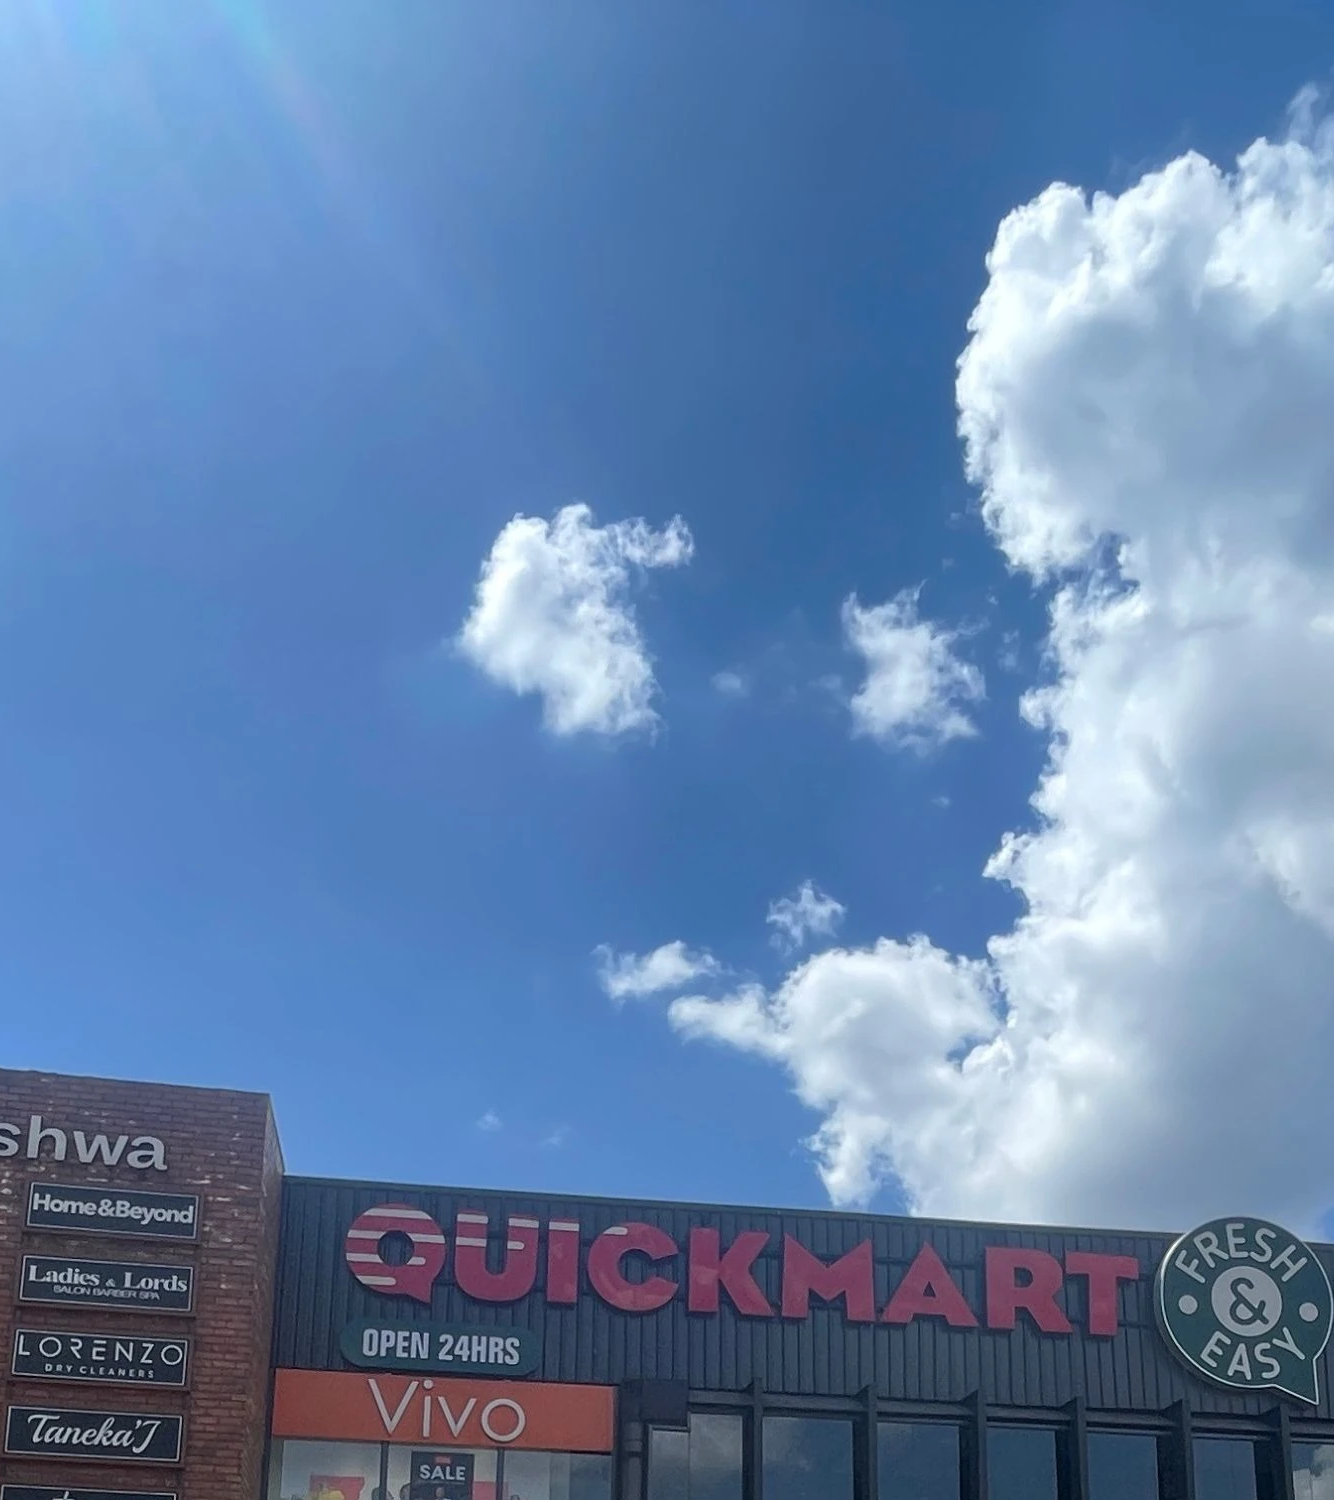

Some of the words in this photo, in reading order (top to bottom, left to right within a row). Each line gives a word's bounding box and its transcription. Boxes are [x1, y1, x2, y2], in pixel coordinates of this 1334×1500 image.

[344, 1202, 1140, 1337] QUICKMART
[1174, 1222, 1308, 1285] FRESH
[28, 1264, 100, 1287] Ladies
[124, 1271, 188, 1293] Lords
[53, 1284, 91, 1297] SALON
[92, 1287, 136, 1299] BARBER
[140, 1290, 160, 1300] SPA
[1228, 1276, 1270, 1327] &
[18, 1333, 183, 1366] LORENZO
[361, 1328, 429, 1360] OPEN
[438, 1333, 521, 1366] 24HRS
[1200, 1326, 1306, 1381] EASY
[44, 1362, 73, 1373] DRY
[79, 1365, 154, 1379] CLEANERS
[367, 1378, 527, 1444] Vivo
[419, 1464, 466, 1481] SALE
